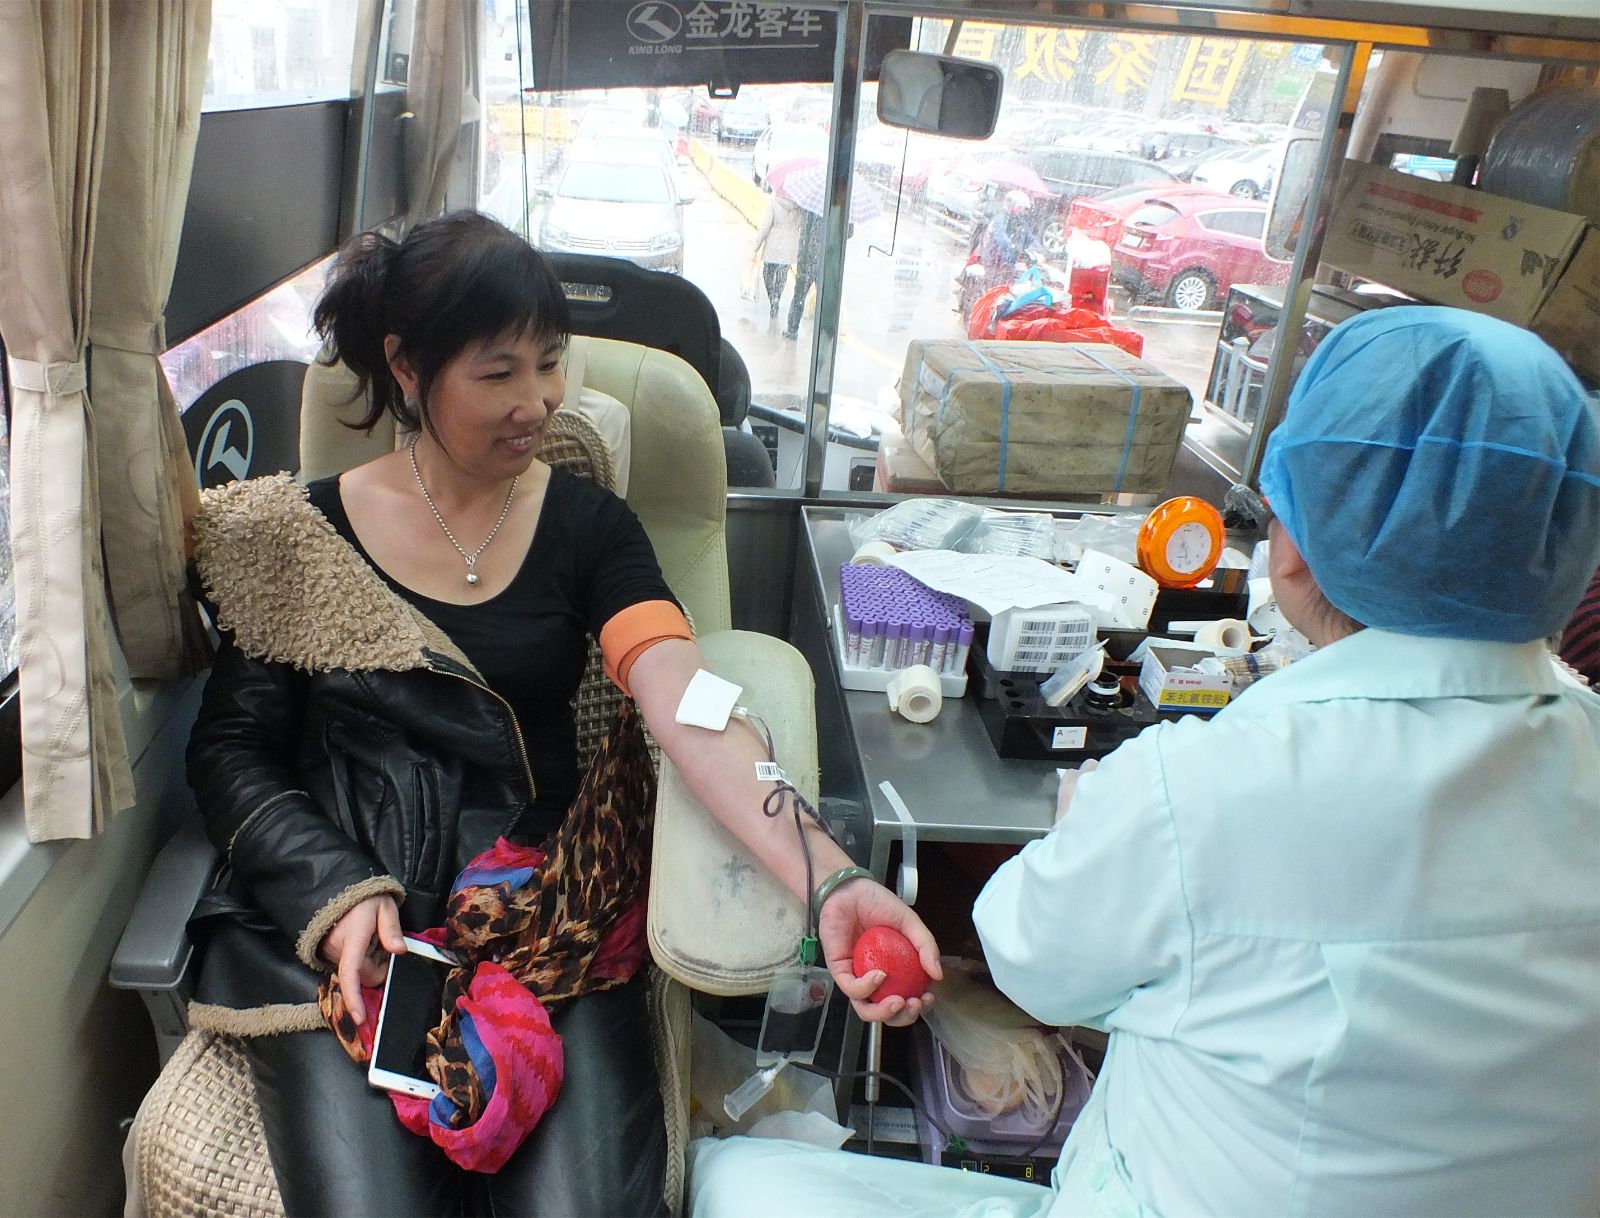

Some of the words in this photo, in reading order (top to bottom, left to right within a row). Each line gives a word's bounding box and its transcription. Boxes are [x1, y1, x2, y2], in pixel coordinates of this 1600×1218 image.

[685, 2, 822, 38] 金龙客车
[629, 45, 652, 55] KING
[655, 45, 682, 54] LONG
[1056, 729, 1064, 737] A
